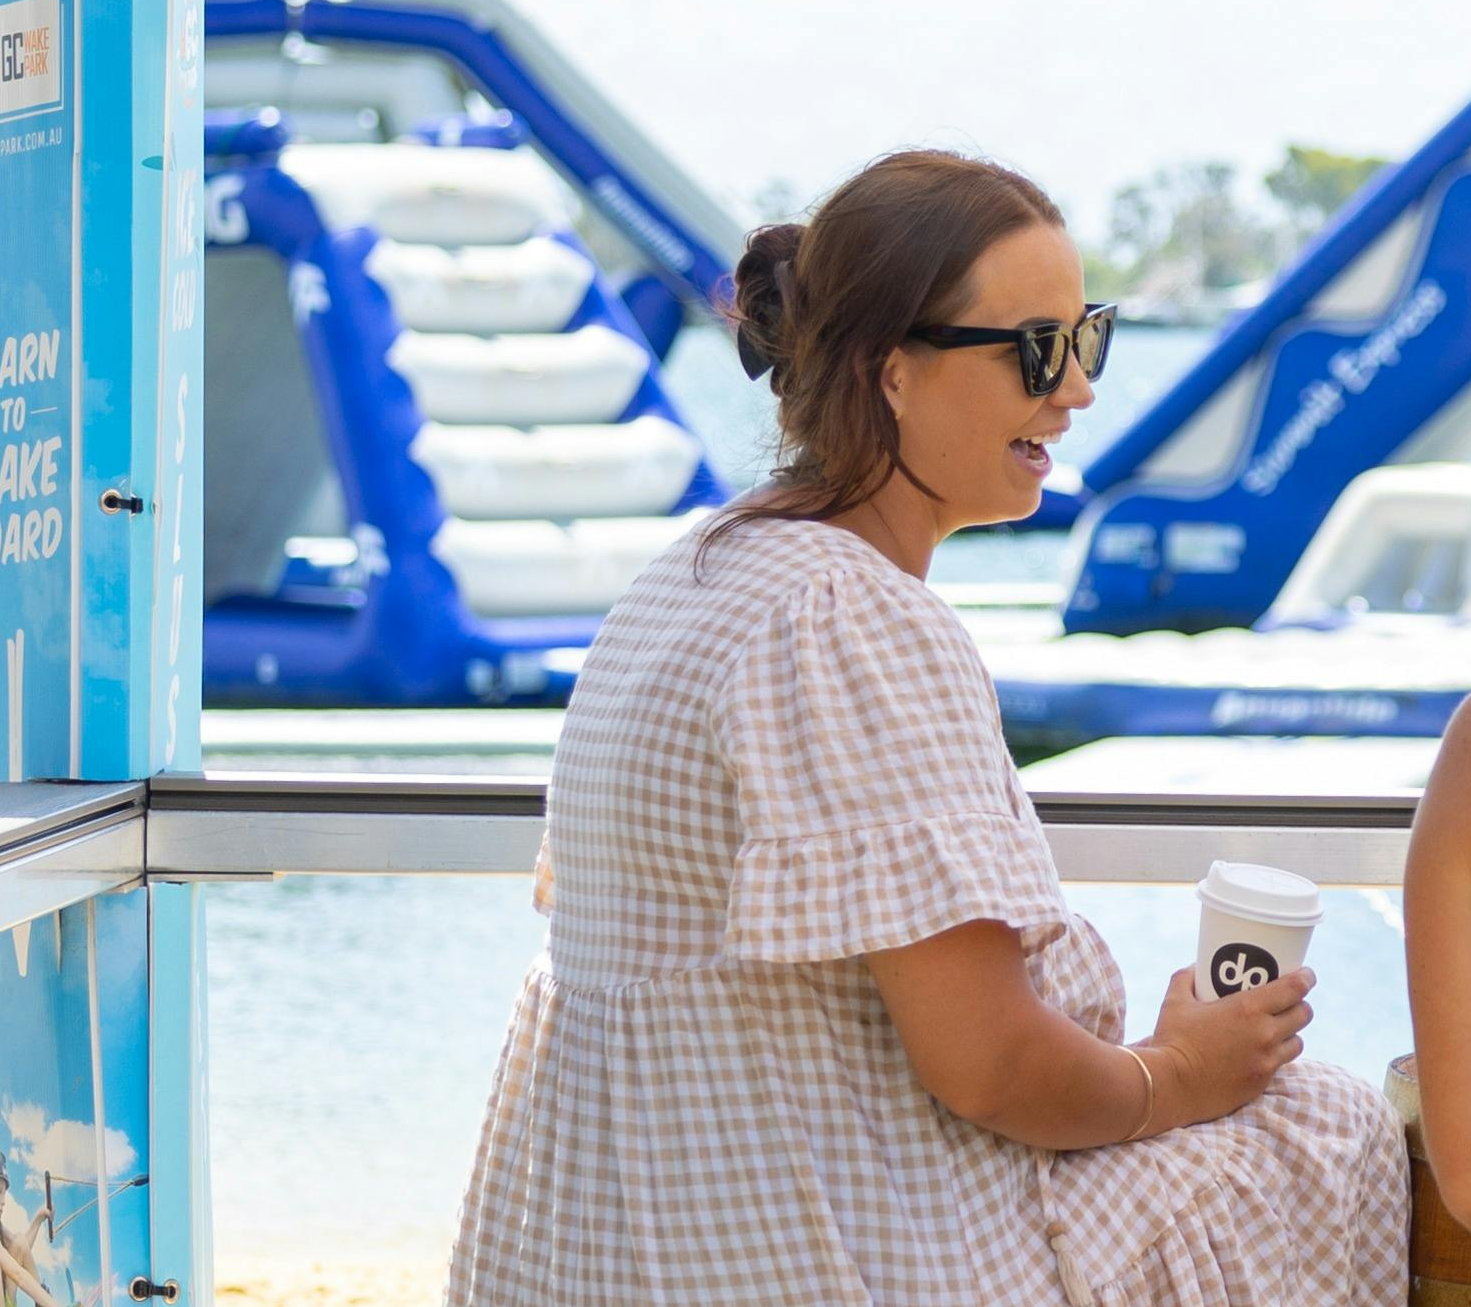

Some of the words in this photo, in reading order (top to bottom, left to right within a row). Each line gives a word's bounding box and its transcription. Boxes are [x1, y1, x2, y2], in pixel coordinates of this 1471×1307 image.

[24, 27, 50, 52] WAKE
[1, 32, 24, 83] GC
[24, 51, 49, 78] PARK
[0, 396, 26, 434] TO
